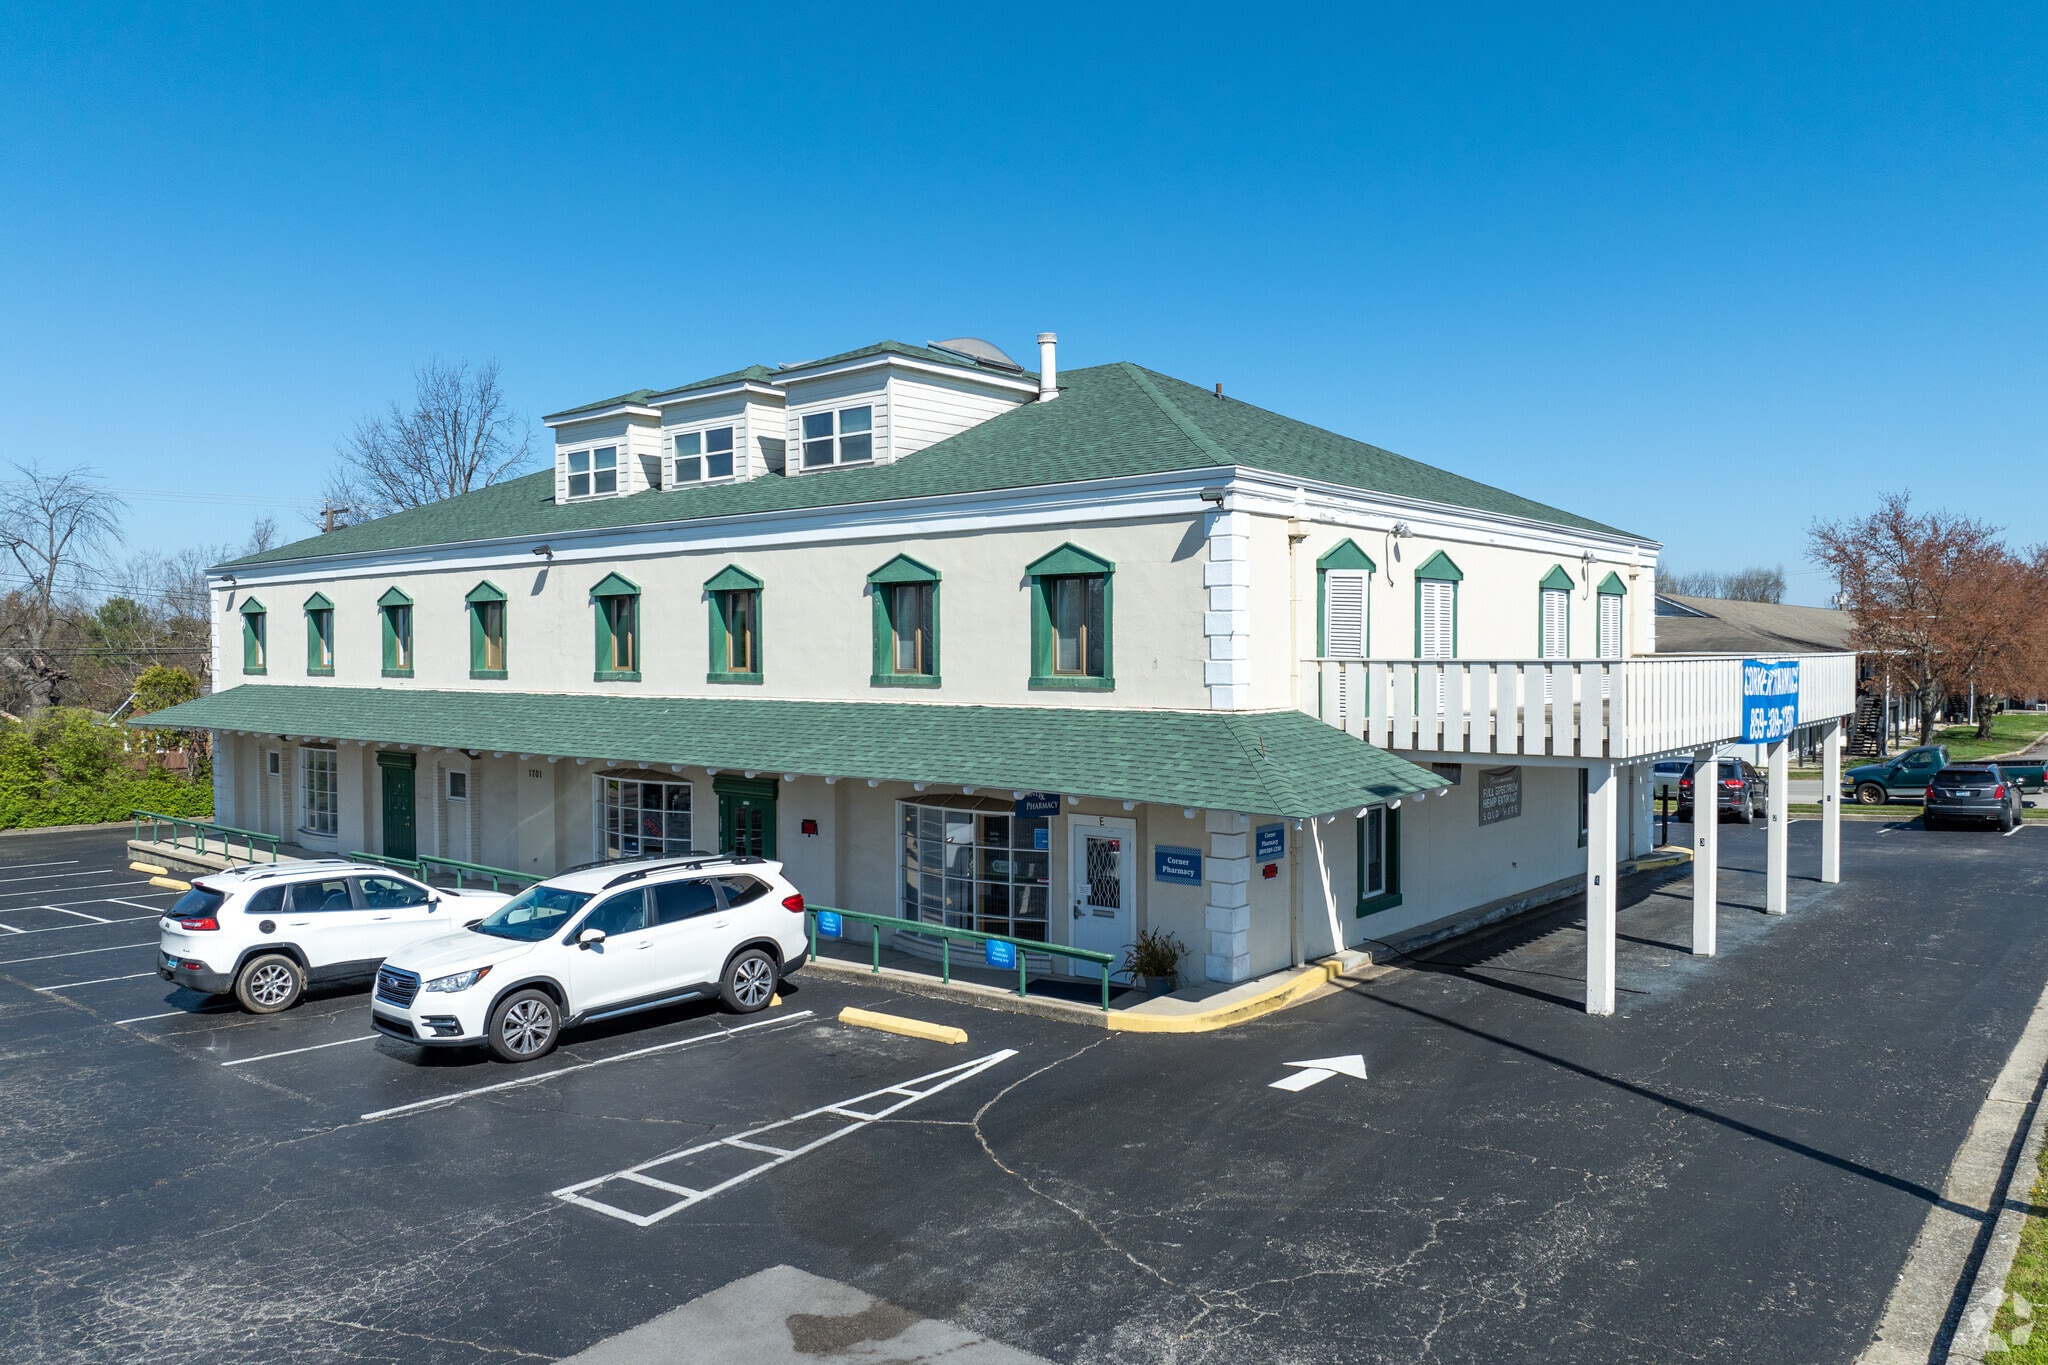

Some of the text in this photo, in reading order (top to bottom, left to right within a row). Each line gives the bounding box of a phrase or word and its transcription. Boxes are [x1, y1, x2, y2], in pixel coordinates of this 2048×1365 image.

[1744, 666, 1774, 696] CORNER
[528, 768, 542, 778] 1701
[1026, 801, 1059, 811] PHARMACY
[1482, 791, 1518, 809] HEMP EXTRACT
[1483, 804, 1518, 821] SOLD HERE
[1099, 816, 1105, 827] E
[1167, 856, 1190, 866] Corner
[1162, 865, 1195, 878] Pharmacy
